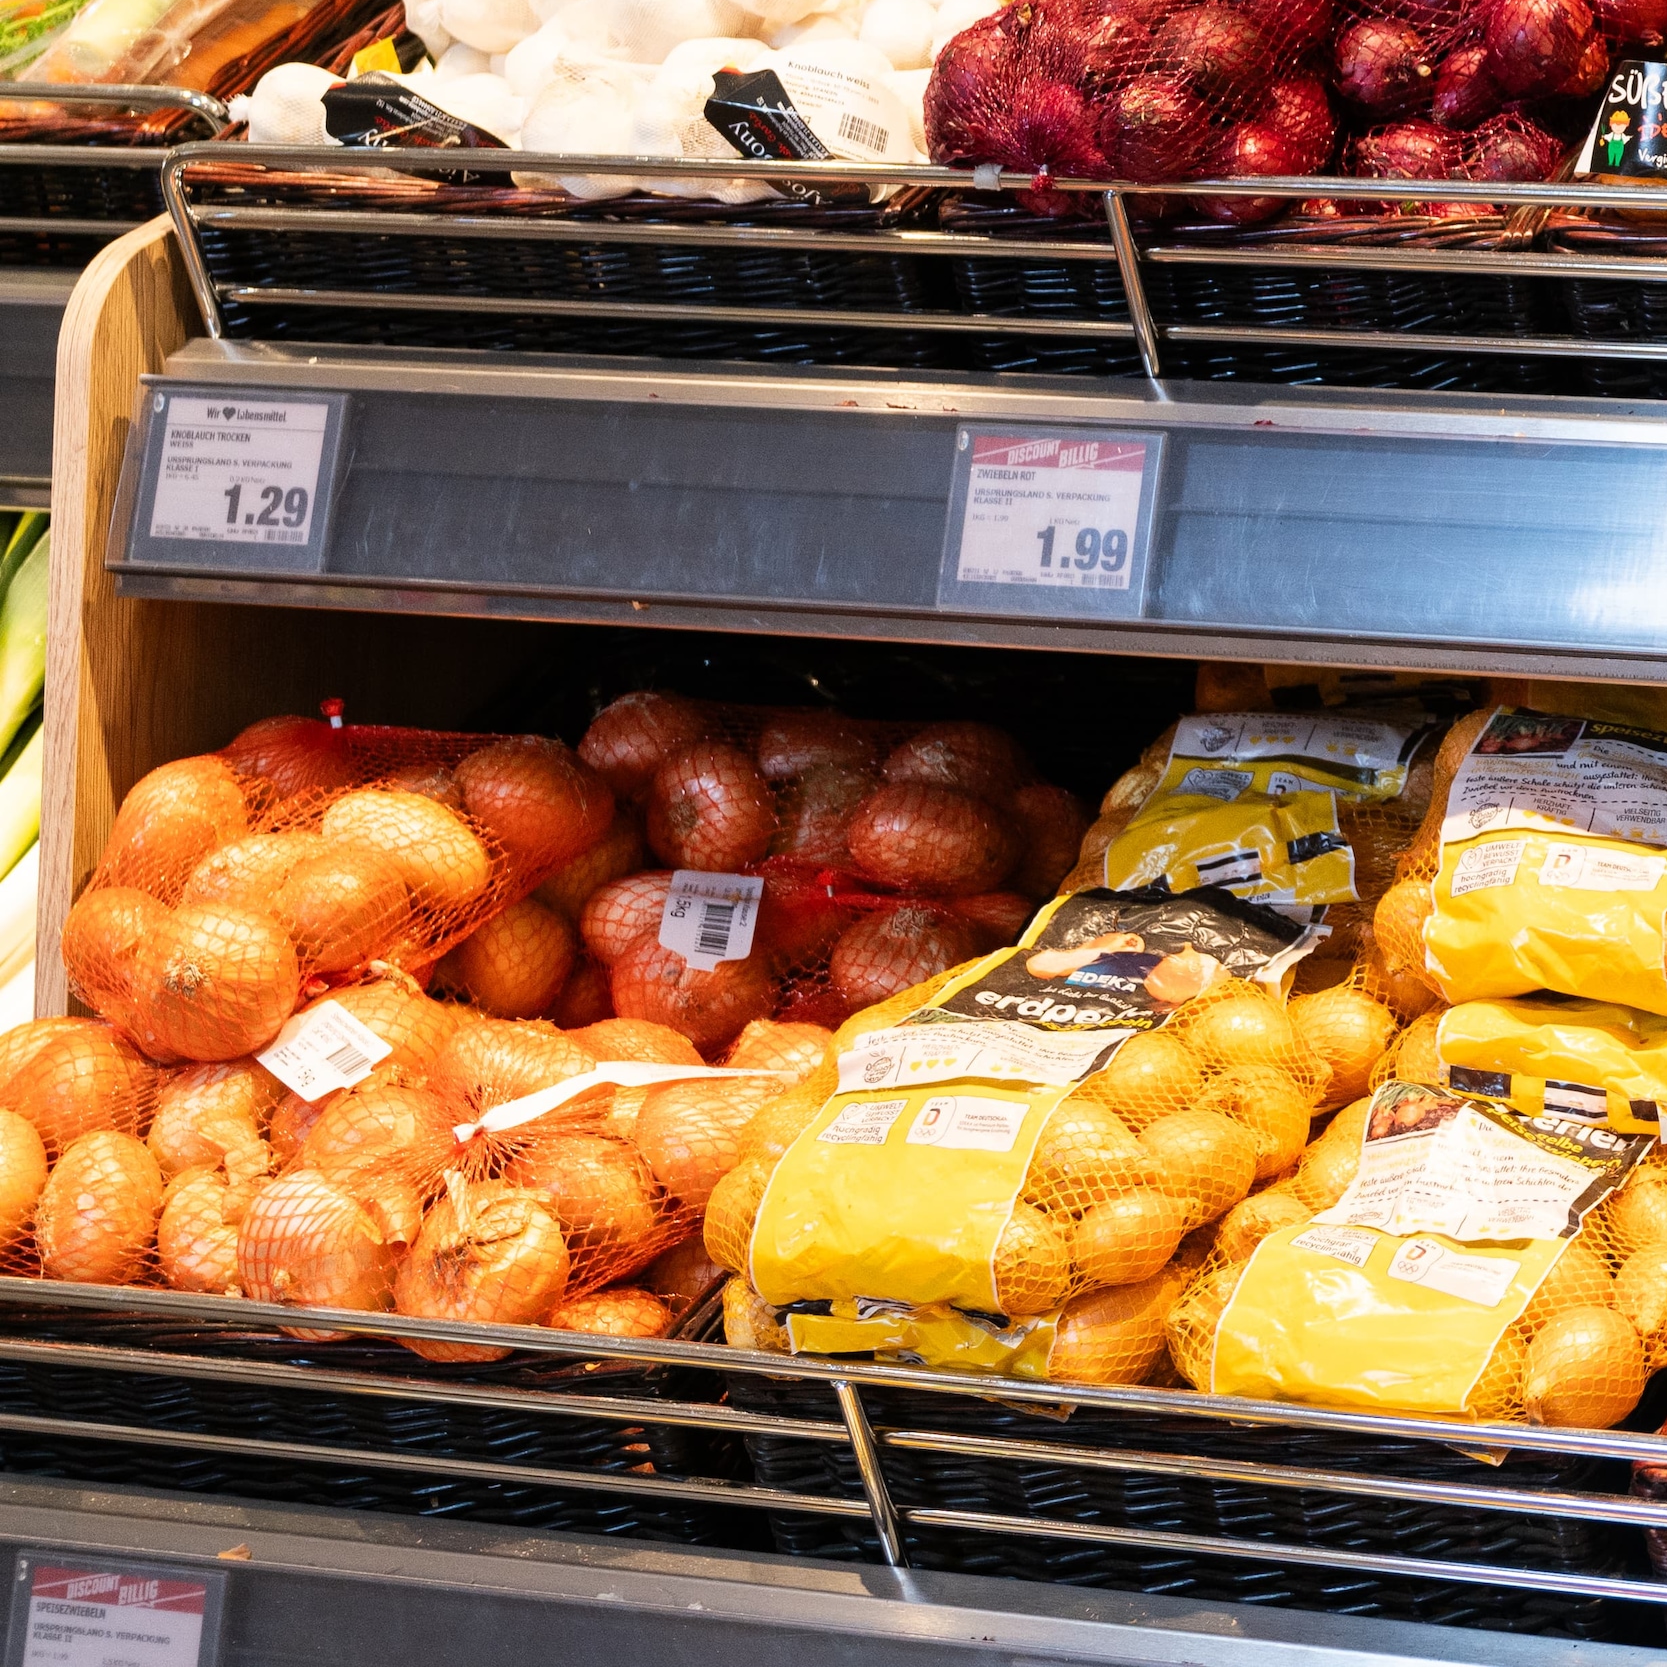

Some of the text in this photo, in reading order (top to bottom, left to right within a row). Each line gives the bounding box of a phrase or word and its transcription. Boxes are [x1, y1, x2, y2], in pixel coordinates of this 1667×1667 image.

[788, 61, 844, 80] Knoblauch
[207, 407, 221, 419] Wir
[171, 430, 251, 443] KNOBLAUCH TROCKEN
[170, 441, 194, 449] WEISS
[1007, 440, 1099, 467] DISCOUNT BILLIG
[167, 456, 232, 467] URSPRUNGSLAND
[242, 460, 293, 469] VERPACKUNG
[977, 470, 1036, 481] ZWIEBELN ROT
[974, 497, 1004, 506] KLASSE
[975, 489, 1045, 499] URSPRUNGSLAND
[1056, 492, 1111, 502] VERPACKUNG
[224, 484, 308, 528] 1.29
[1037, 526, 1128, 572] 1.99
[1557, 761, 1576, 770] und
[1602, 761, 1632, 770] einem
[1521, 777, 1551, 787] Schale
[1587, 782, 1601, 790] die
[1533, 797, 1573, 810] HERZHAFT-
[1536, 805, 1567, 816] KRÄFTIG
[1624, 807, 1661, 817] VIELSEITIG
[1616, 814, 1666, 824] VERWENDBAR
[1485, 841, 1523, 852] UMWELT-
[1483, 849, 1520, 860] BEWUSST
[1482, 857, 1517, 867] VERPACKT
[1454, 875, 1511, 894] recyclingfähig
[1067, 971, 1138, 993] EDEKA
[822, 1132, 883, 1143] recyclingfähig
[1537, 1133, 1584, 1152] gelbe
[66, 1575, 159, 1606] DISCOUNT BILLIG
[36, 1602, 106, 1619] SPEISEZWIEBELN
